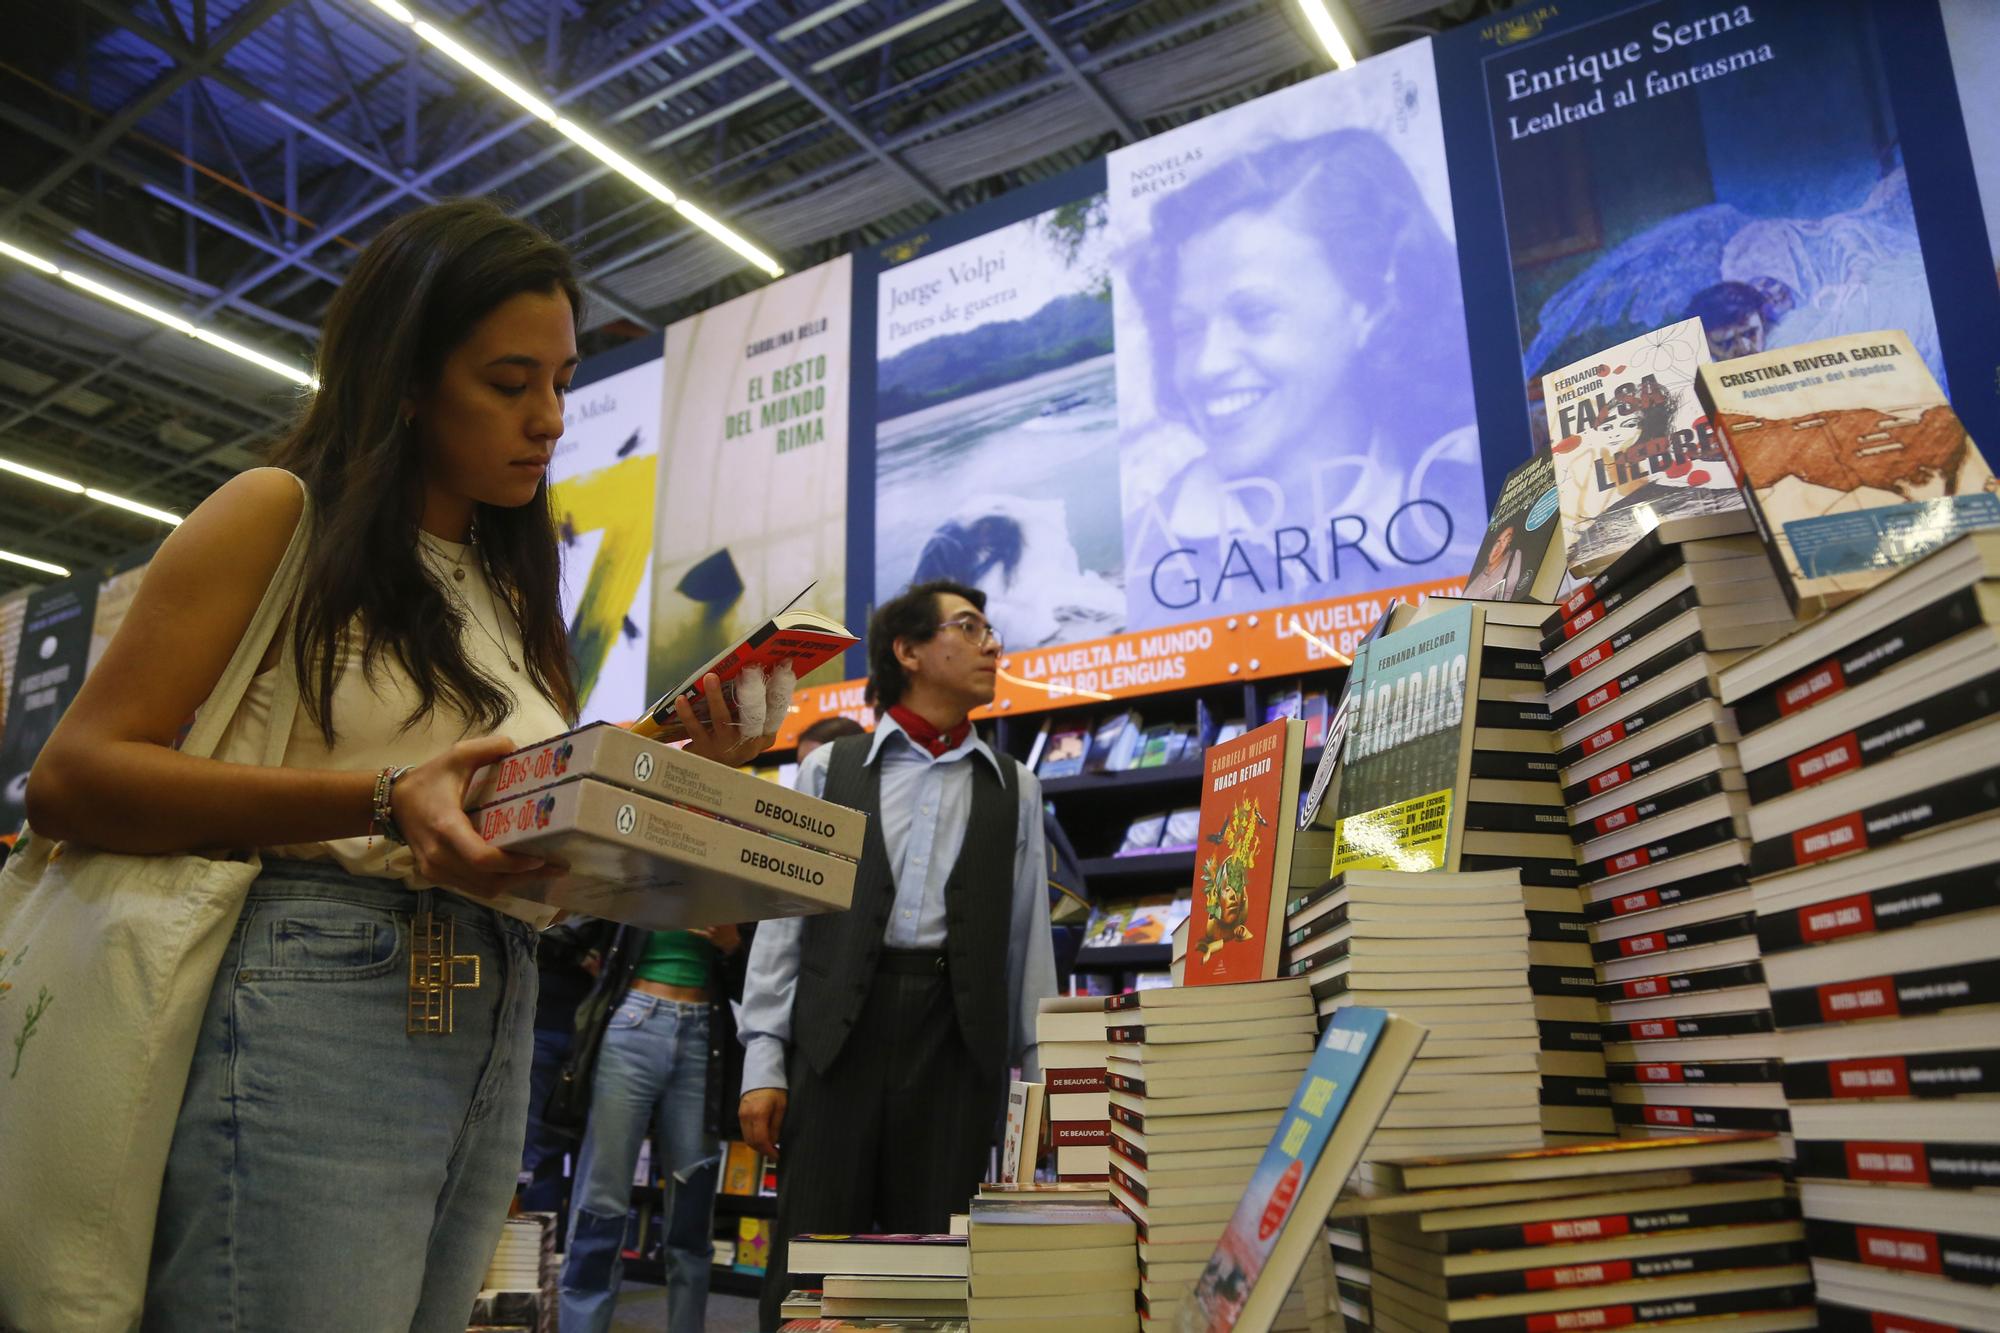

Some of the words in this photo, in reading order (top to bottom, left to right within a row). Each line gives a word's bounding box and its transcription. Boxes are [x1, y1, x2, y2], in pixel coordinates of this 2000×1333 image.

[1506, 41, 1642, 101] Enrique
[1652, 5, 1755, 54] Serna
[1508, 89, 1605, 140] Lealtad
[1613, 78, 1636, 108] al
[1645, 43, 1775, 98] fantasma
[1131, 147, 1203, 182] NOVELAS
[1131, 169, 1186, 198] BREVES
[889, 279, 942, 316] Jorge
[949, 250, 1006, 285] Volpi
[889, 317, 935, 341] Partes
[939, 304, 959, 323] de
[964, 288, 1017, 321] guerra
[748, 376, 763, 403] EL
[772, 354, 826, 394] RESTO
[1554, 364, 1605, 392] FERNANDA
[1719, 363, 1792, 389] CRISTINA
[1793, 351, 1849, 376] RIVERA
[1850, 343, 1902, 364] GARZA
[1826, 371, 1846, 384] del
[1556, 379, 1603, 405] MELCHOR
[1559, 374, 1665, 439] FALSA
[725, 410, 752, 440] DEL
[760, 385, 825, 429] MUNDO
[776, 416, 824, 454] RIMA
[1594, 421, 1720, 492] LIEBRE
[1151, 499, 1454, 609] GARRO
[1276, 613, 1301, 639] LA
[1304, 600, 1382, 632] VUELTA
[1023, 656, 1047, 680] LA
[1048, 645, 1112, 674] VUELTA
[1115, 640, 1138, 664] AL
[1140, 627, 1213, 658] MUNDO
[1307, 634, 1336, 660] EN
[1377, 646, 1416, 672] FERNANDA
[1418, 630, 1456, 655] MELCHOR
[1048, 676, 1072, 699] EN
[1076, 671, 1098, 694] 80
[1102, 656, 1186, 690] LENGUAS
[819, 692, 839, 712] LA
[1344, 654, 1467, 766] PÁRADAIS
[666, 760, 700, 781] Penguin
[1211, 747, 1246, 774] GABRIELA
[1248, 734, 1278, 760] WIENER
[662, 781, 689, 798] Grupo
[688, 788, 723, 807] Editorial
[664, 771, 699, 792] Random
[698, 781, 722, 797] House
[1213, 771, 1238, 793] HUACO
[1240, 757, 1271, 783] RETRATO
[647, 823, 682, 840] Random
[682, 832, 707, 848] House
[649, 812, 684, 831] Penguin
[644, 832, 671, 850] Grupo
[671, 841, 707, 859] Editorial
[1063, 1078, 1098, 1086] BEAUVOIR
